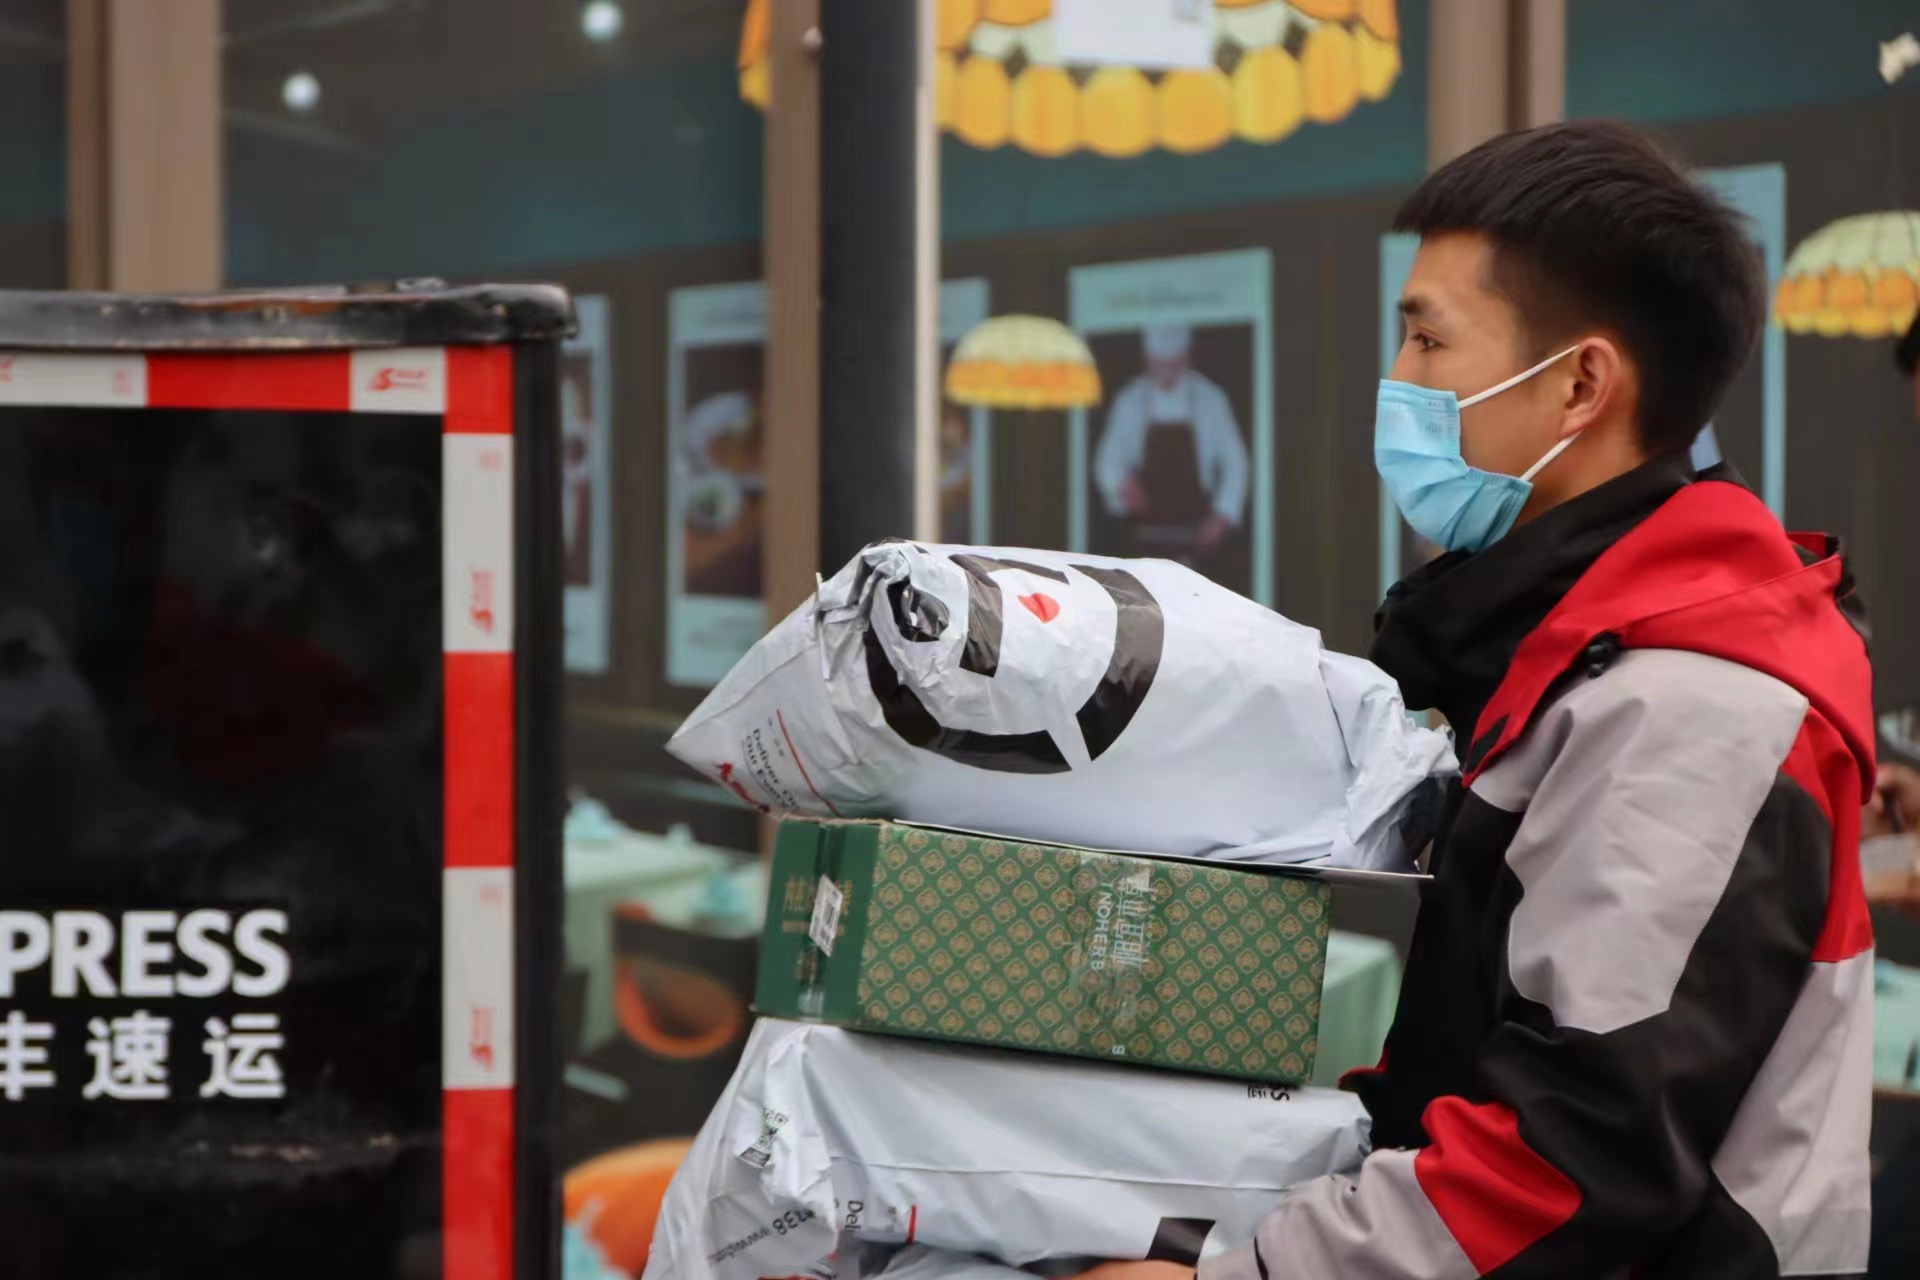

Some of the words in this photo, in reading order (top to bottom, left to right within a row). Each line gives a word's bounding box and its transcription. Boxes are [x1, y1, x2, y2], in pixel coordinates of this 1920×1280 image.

[0, 908, 291, 998] PRESS
[0, 1010, 286, 1101] 丰速运
